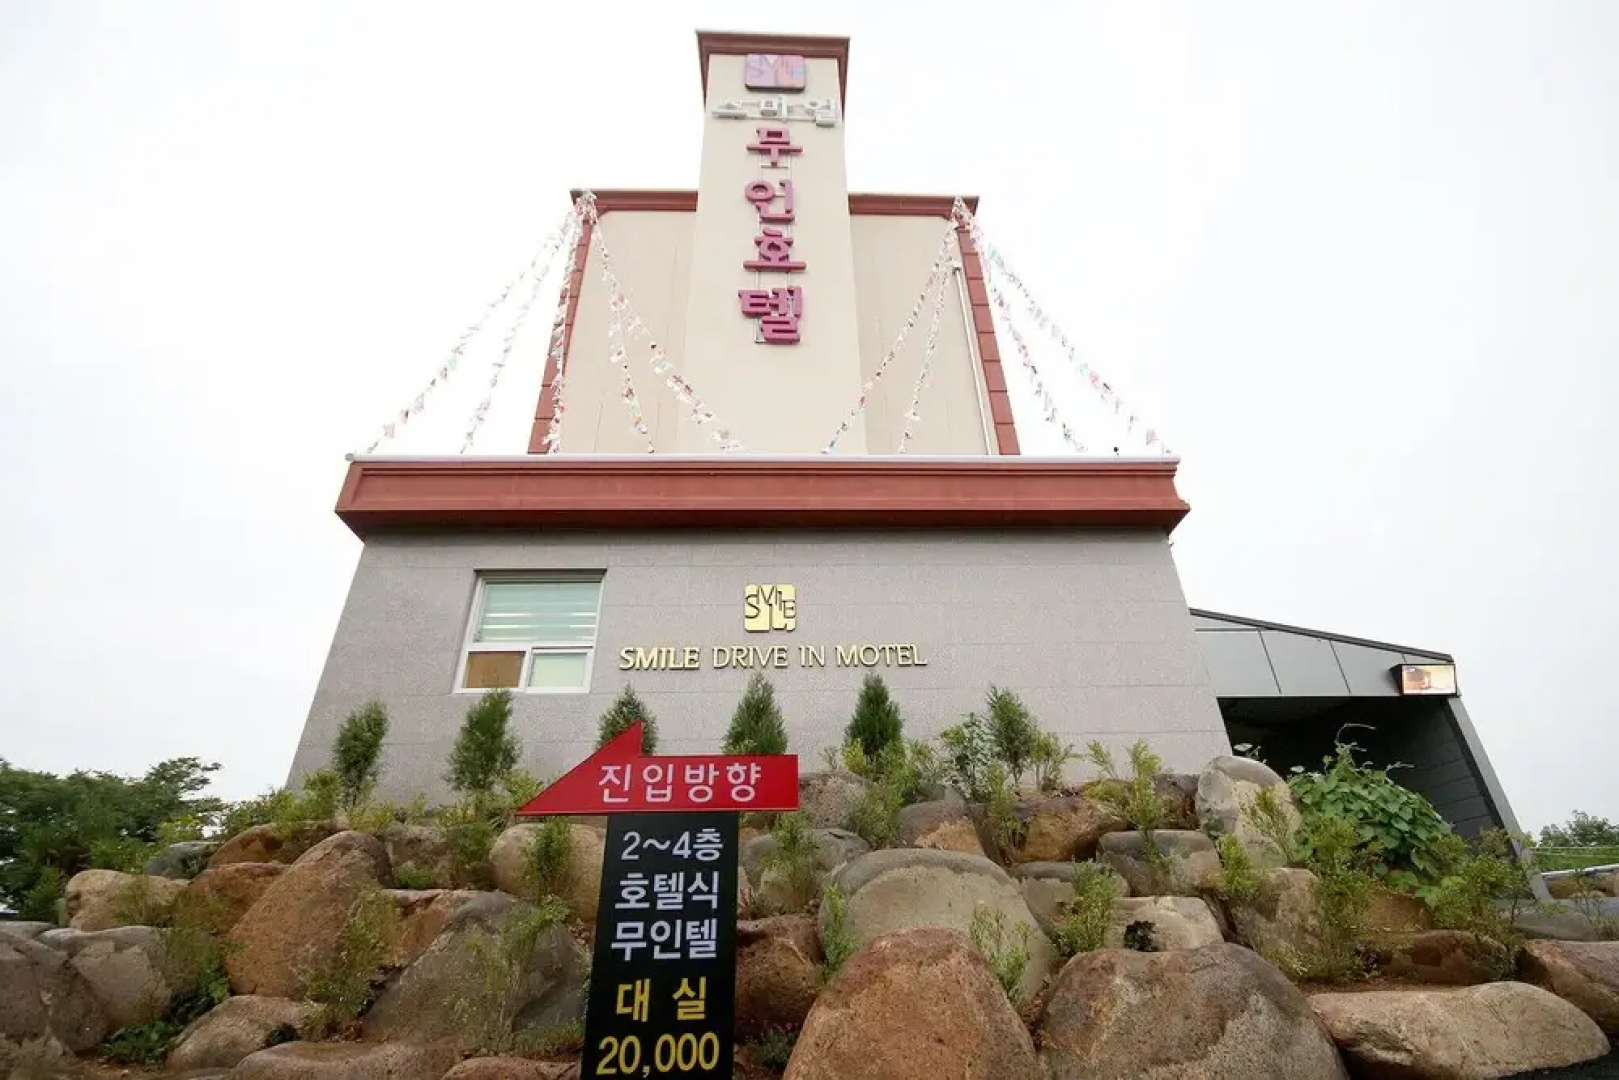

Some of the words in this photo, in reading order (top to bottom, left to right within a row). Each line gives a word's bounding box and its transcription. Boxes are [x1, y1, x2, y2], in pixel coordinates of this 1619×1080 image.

[738, 127, 807, 344] 무인호텔
[619, 646, 700, 671] SMILE
[713, 646, 788, 668] DRIVE
[800, 645, 826, 668] IN
[836, 644, 927, 667] MOTEL
[598, 762, 762, 804] 진입방향
[614, 871, 720, 911] 호텔식
[611, 917, 718, 962] 무인텔
[595, 1031, 720, 1078] 20,000
